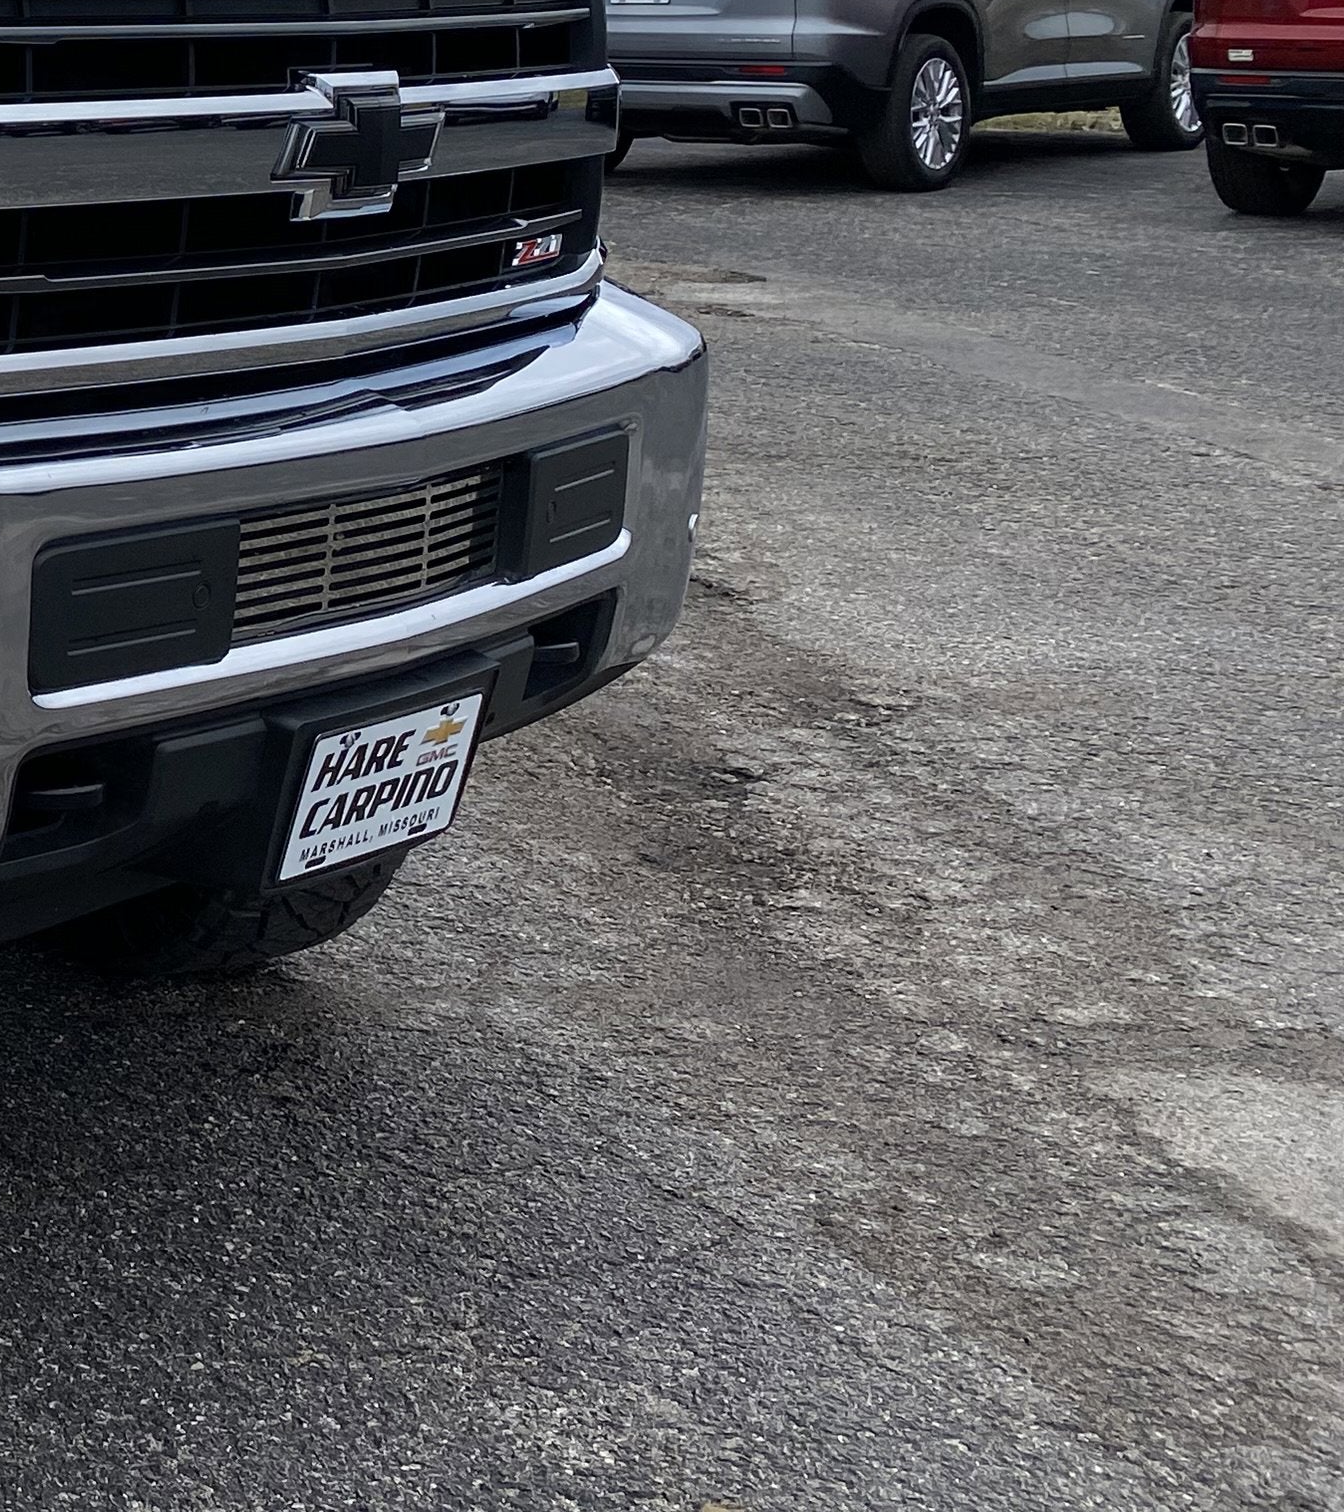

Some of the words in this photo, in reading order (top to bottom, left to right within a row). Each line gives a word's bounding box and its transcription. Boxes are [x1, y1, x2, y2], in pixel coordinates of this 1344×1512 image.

[512, 234, 562, 266] Z71
[311, 729, 417, 792] HARE
[416, 743, 459, 766] GMC
[299, 759, 459, 839] CARPINO
[299, 829, 374, 862] MARSHALL,
[378, 806, 440, 837] MISSOURI
